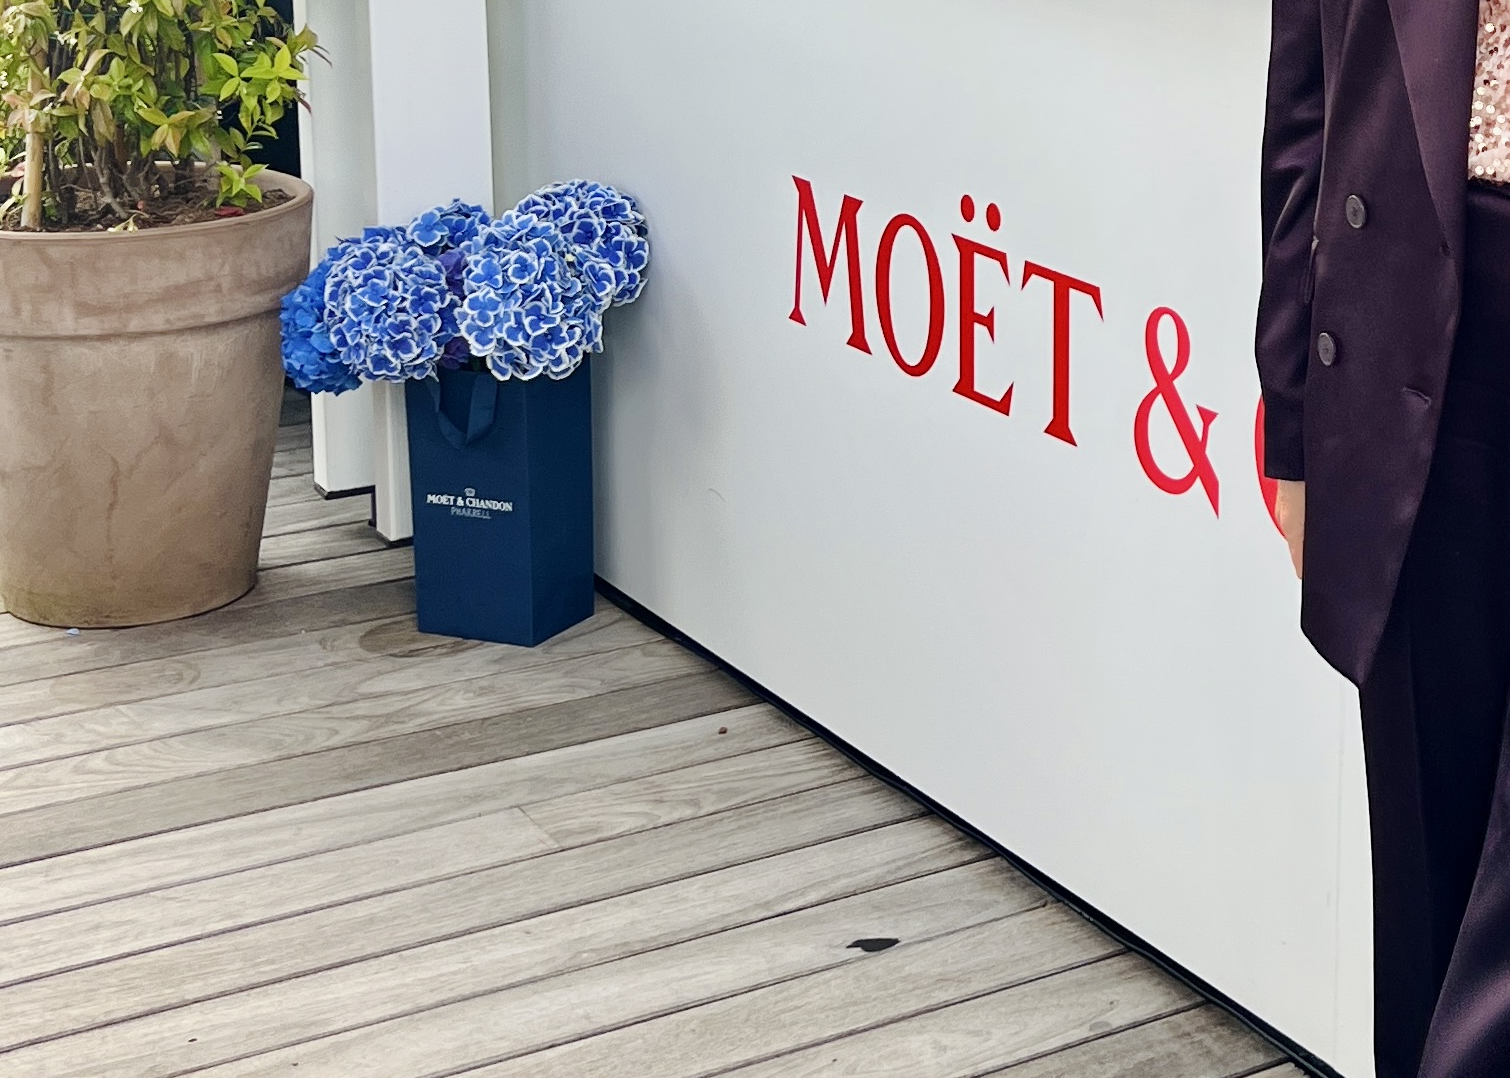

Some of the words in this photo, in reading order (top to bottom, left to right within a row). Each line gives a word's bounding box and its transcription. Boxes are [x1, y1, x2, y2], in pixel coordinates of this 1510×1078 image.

[789, 174, 1105, 448] MOËT
[1134, 306, 1220, 520] &
[456, 497, 464, 507] &
[465, 498, 513, 511] CHANDON
